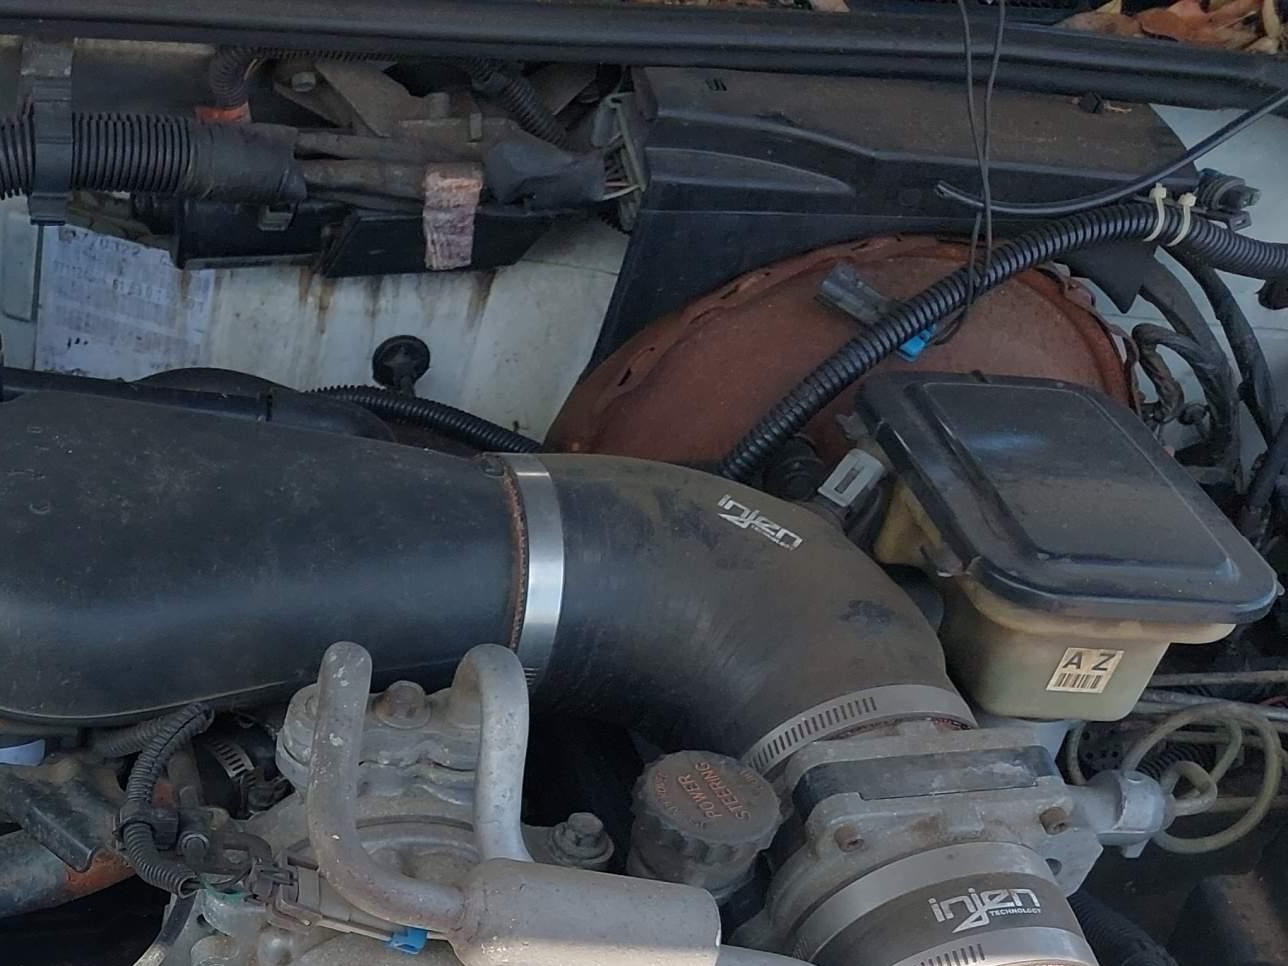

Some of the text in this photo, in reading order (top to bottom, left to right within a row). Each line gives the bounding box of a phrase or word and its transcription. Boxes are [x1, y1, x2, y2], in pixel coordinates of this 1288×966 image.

[1062, 651, 1116, 671] A Z
[677, 773, 724, 820] POWER
[695, 760, 753, 824] STEERING
[927, 887, 1041, 934] injen
